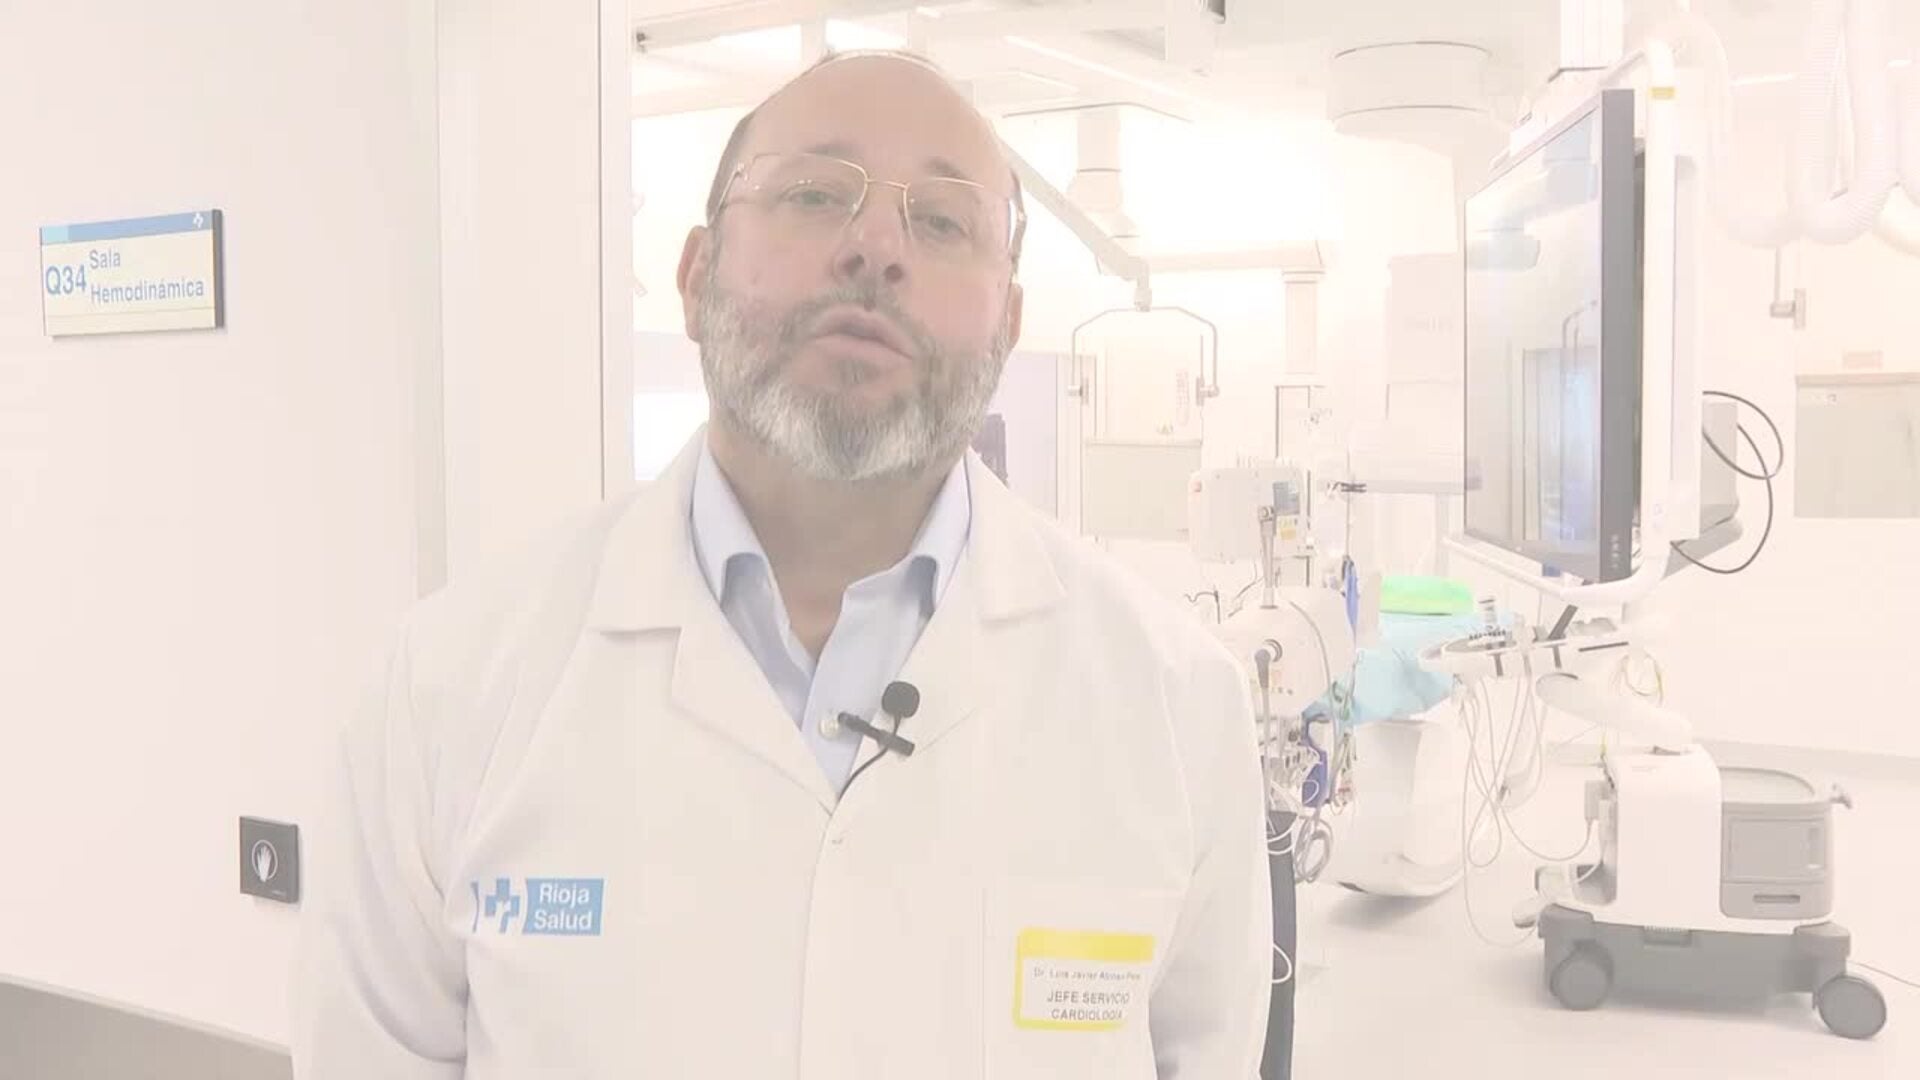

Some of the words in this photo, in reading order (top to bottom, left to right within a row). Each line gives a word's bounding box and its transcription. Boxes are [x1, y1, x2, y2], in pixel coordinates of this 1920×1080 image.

[89, 249, 121, 270] Sala
[45, 264, 87, 295] Q34
[91, 277, 205, 305] Hemodinámica
[539, 882, 590, 909] Rioja
[533, 909, 593, 931] Salud
[1046, 990, 1080, 1004] JEFE
